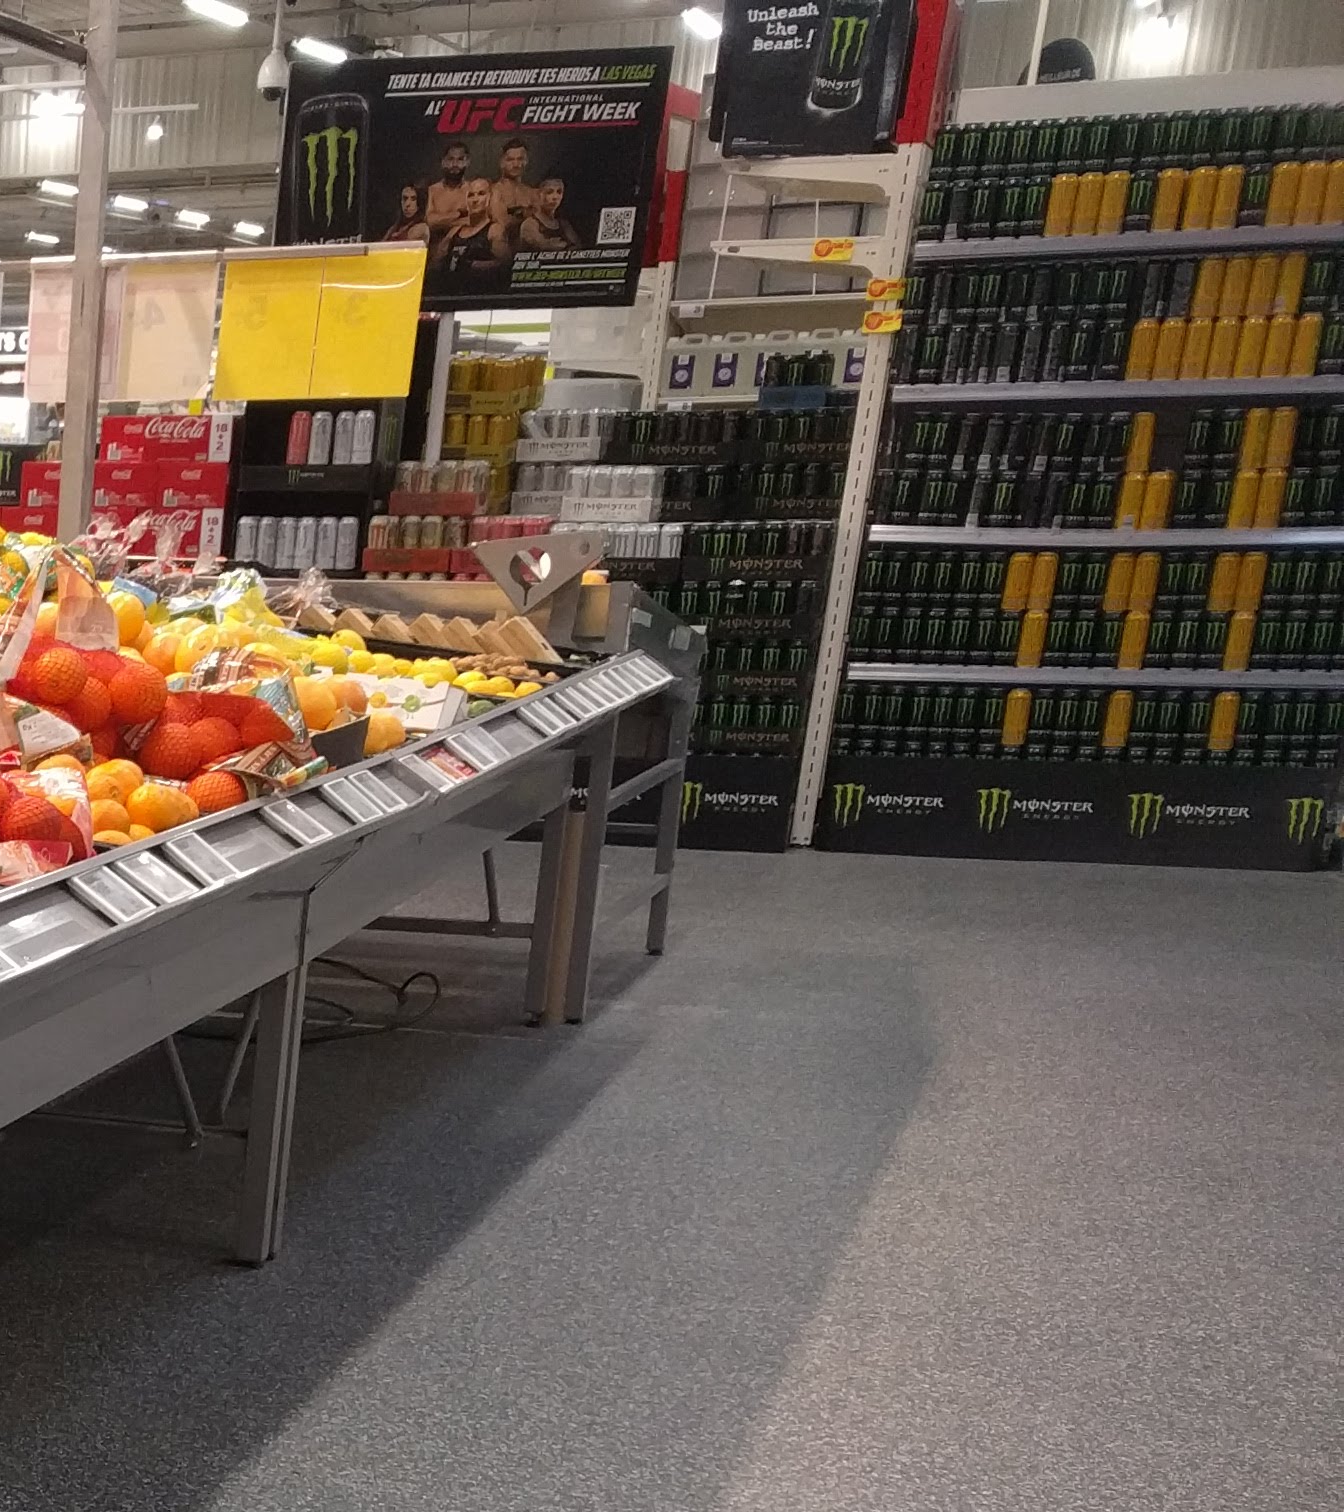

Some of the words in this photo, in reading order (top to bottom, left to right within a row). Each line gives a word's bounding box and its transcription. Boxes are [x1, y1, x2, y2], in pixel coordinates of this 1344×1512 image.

[747, 2, 820, 23] Unleash
[766, 22, 798, 36] the
[752, 29, 816, 52] Beast!
[387, 74, 420, 90] TENTE
[419, 73, 431, 88] TA
[428, 71, 469, 88] CHANCE
[468, 70, 482, 86] ET
[482, 69, 538, 86] RETROUVE
[537, 68, 560, 84] TES
[600, 65, 623, 80] LAS
[620, 64, 657, 79] VEGAS
[528, 94, 604, 104] INTERNATIONAL
[437, 98, 525, 133] UFC
[521, 104, 582, 124] FIGHT
[582, 101, 641, 121] WEEK
[215, 423, 228, 434] 18
[216, 441, 224, 452] 2
[586, 502, 642, 513] MONSTER
[206, 516, 219, 527] 18
[729, 558, 804, 570] MONSTER
[733, 676, 798, 687] MONSTER
[704, 792, 779, 806] MONSTER
[867, 793, 945, 808] MONSTER
[1013, 798, 1094, 813] MONSTER
[1166, 803, 1251, 819] MONSTER
